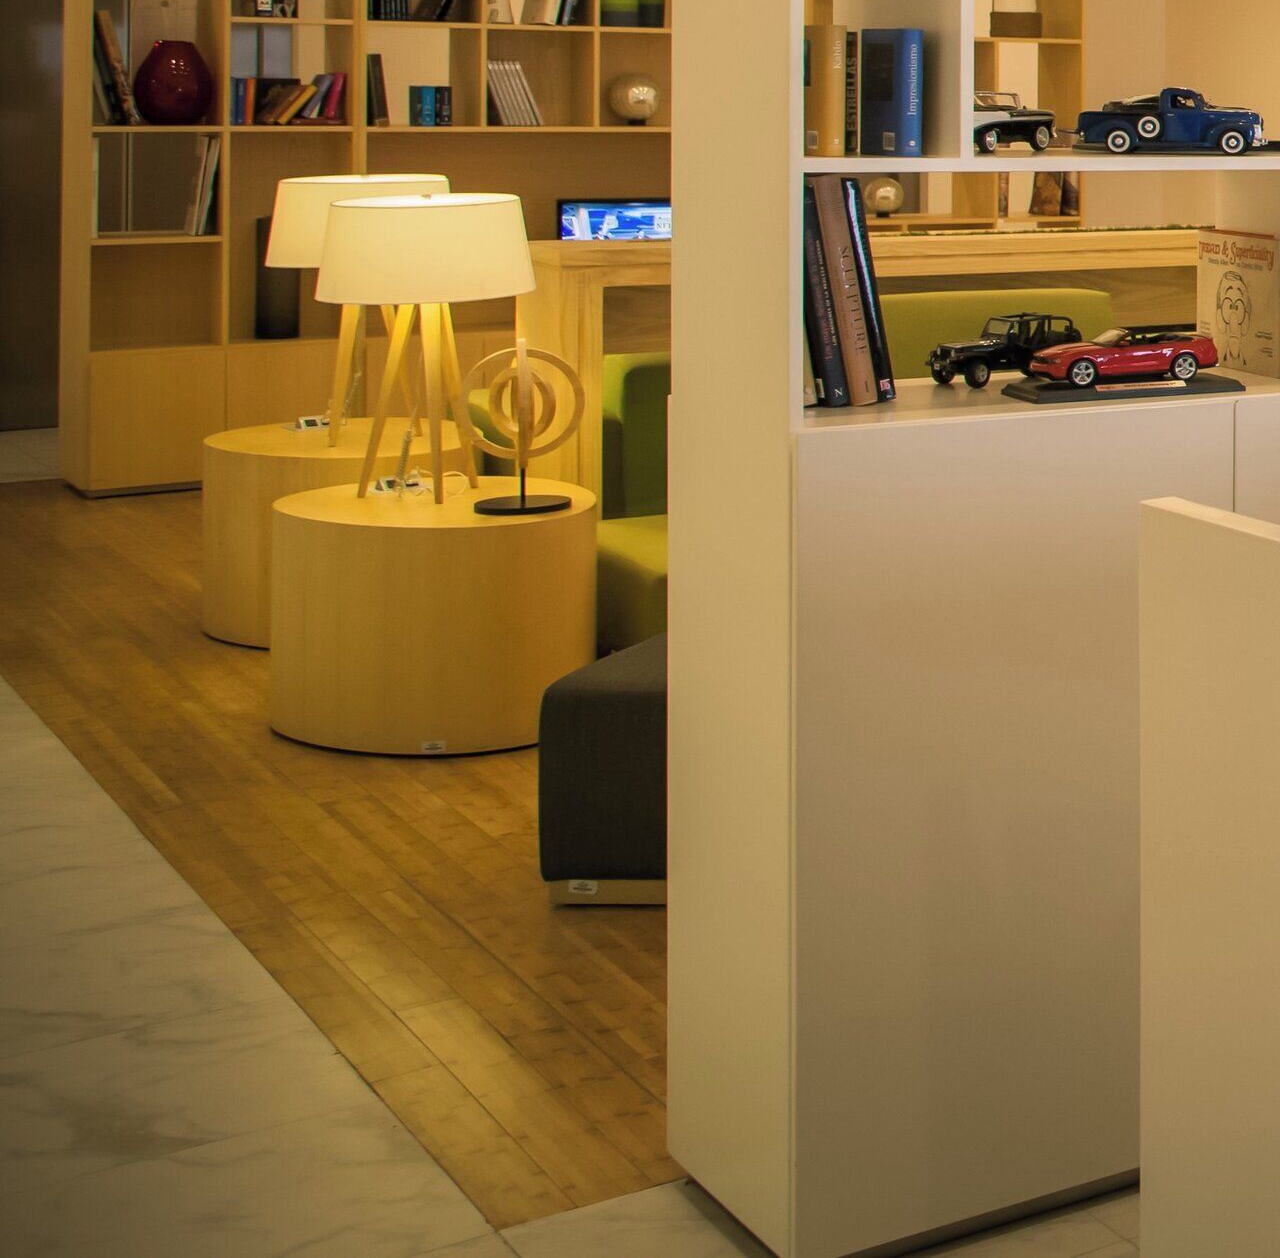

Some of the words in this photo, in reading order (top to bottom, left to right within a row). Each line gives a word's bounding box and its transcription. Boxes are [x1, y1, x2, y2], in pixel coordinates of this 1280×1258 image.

[832, 40, 842, 69] Kahlo
[907, 43, 919, 116] Impresionismo
[846, 57, 857, 131] ESTRELLAS
[838, 245, 868, 356] SCULPTURE
